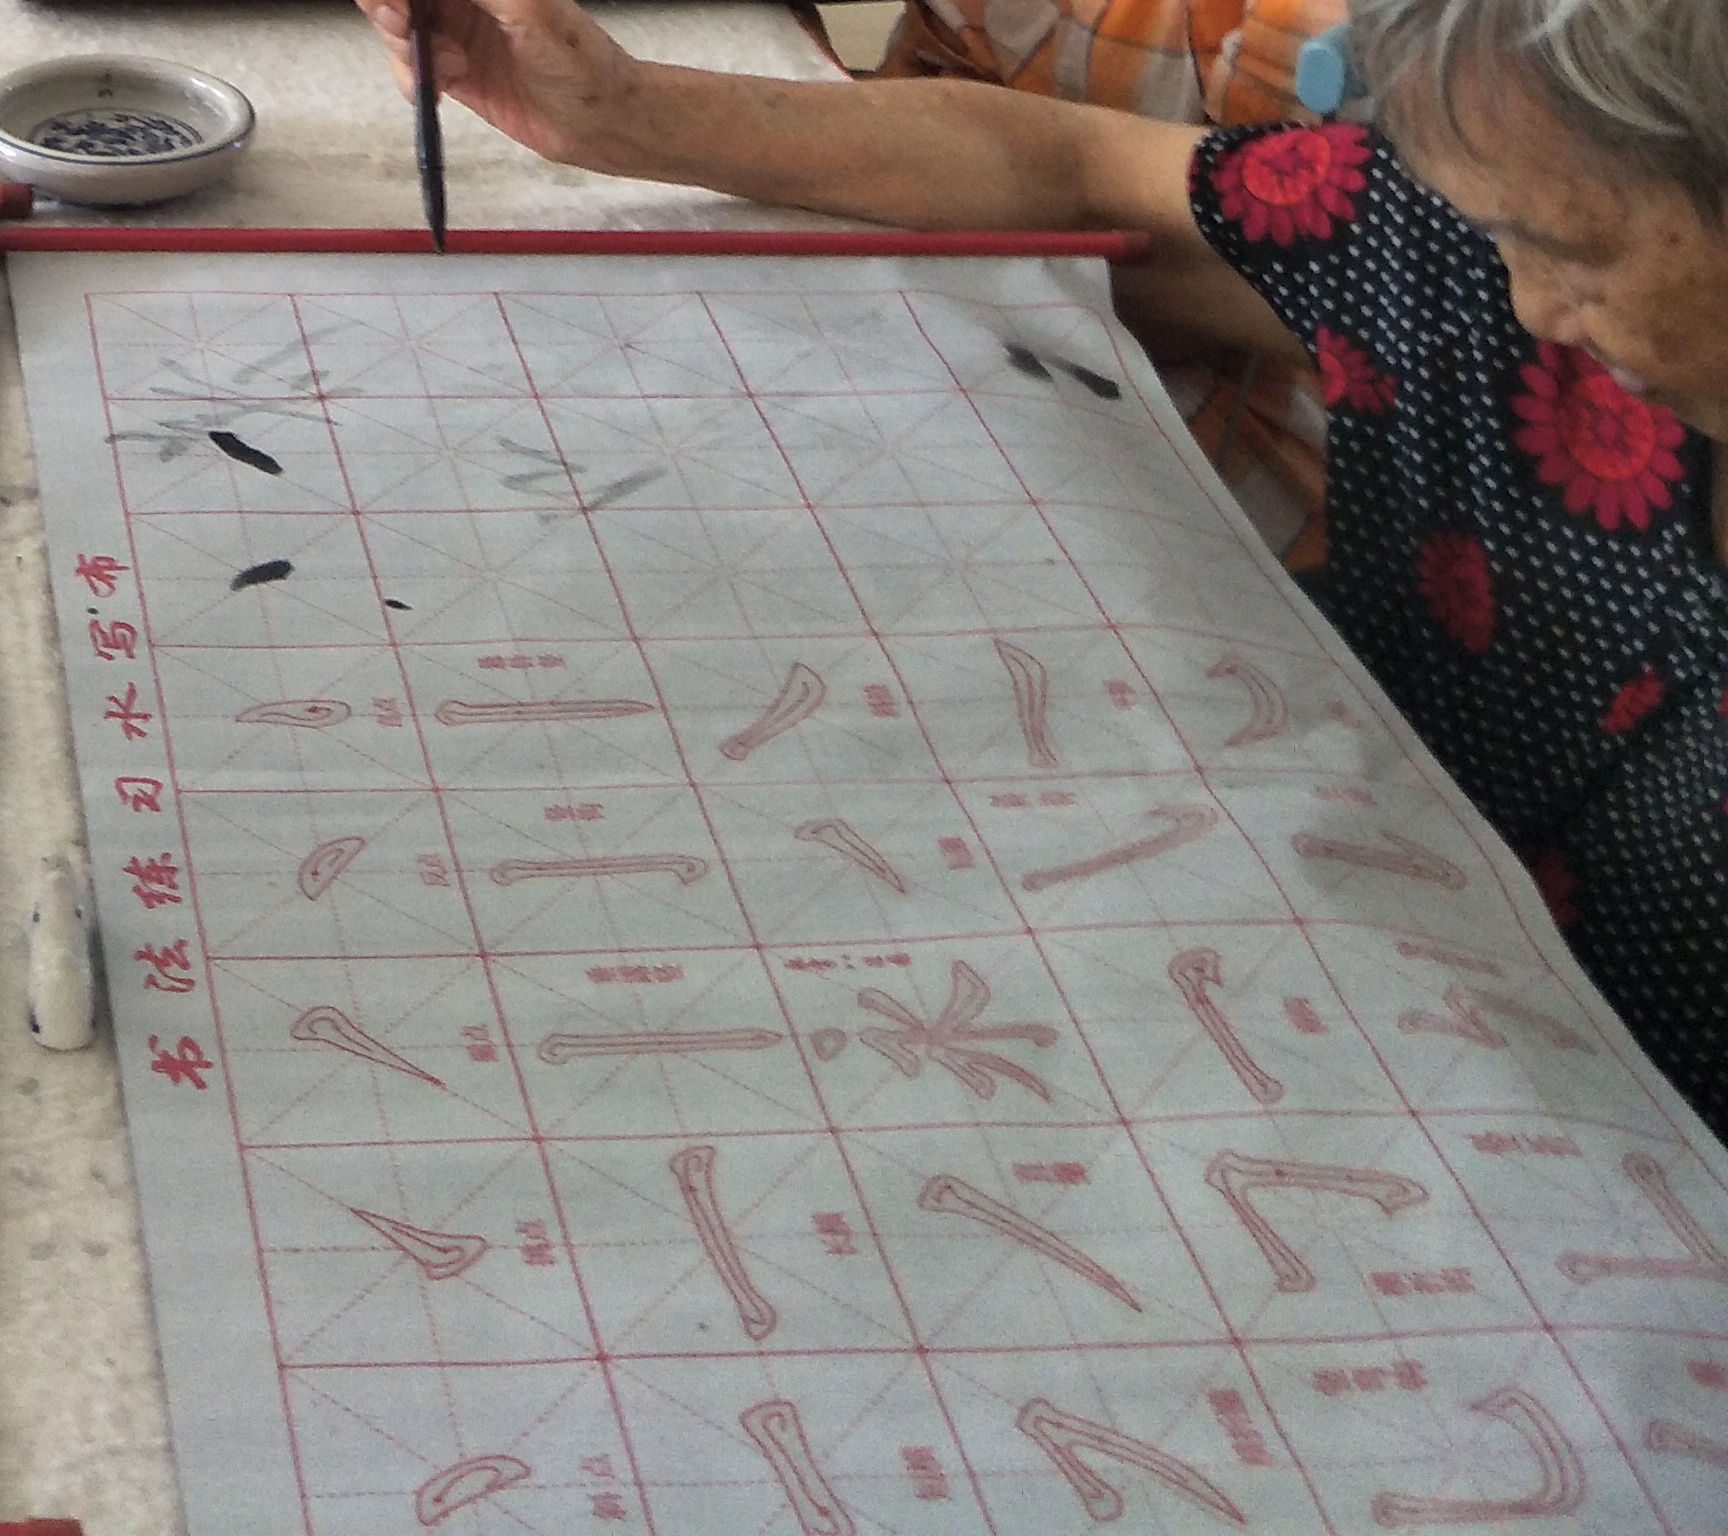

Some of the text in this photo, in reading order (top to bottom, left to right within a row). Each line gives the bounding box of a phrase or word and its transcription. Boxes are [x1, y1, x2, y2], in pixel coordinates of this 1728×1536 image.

[74, 552, 213, 1092] 书法练习水写布
